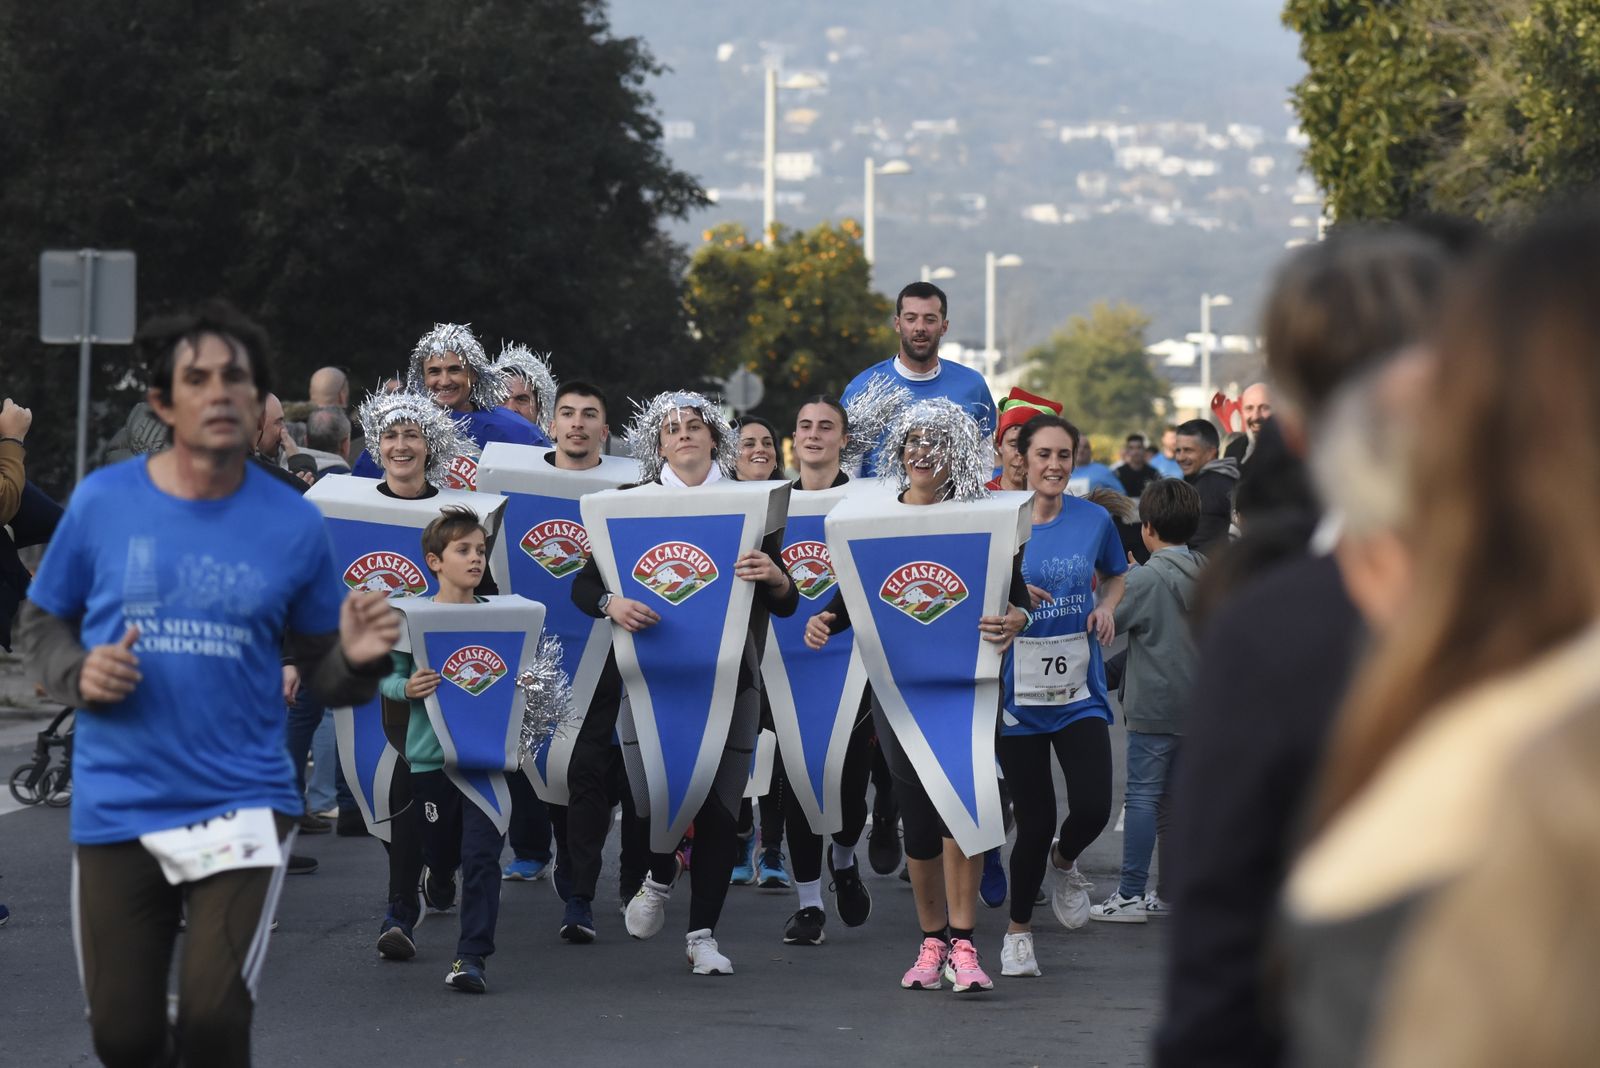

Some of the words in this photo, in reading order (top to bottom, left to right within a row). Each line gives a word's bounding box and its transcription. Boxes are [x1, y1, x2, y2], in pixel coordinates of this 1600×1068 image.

[528, 530, 546, 546] EL
[640, 557, 659, 574] EL
[655, 545, 711, 573] CASERIO
[789, 544, 831, 563] CASER
[350, 563, 369, 580] EL
[366, 555, 420, 585] CASERIO
[886, 577, 906, 594] EL
[901, 565, 960, 592] CASERIO
[1036, 594, 1086, 610] SILVESTR
[1029, 604, 1083, 621] RDOBESA
[447, 659, 462, 672] EL
[458, 648, 501, 670] CASERIO
[1041, 656, 1068, 676] 76
